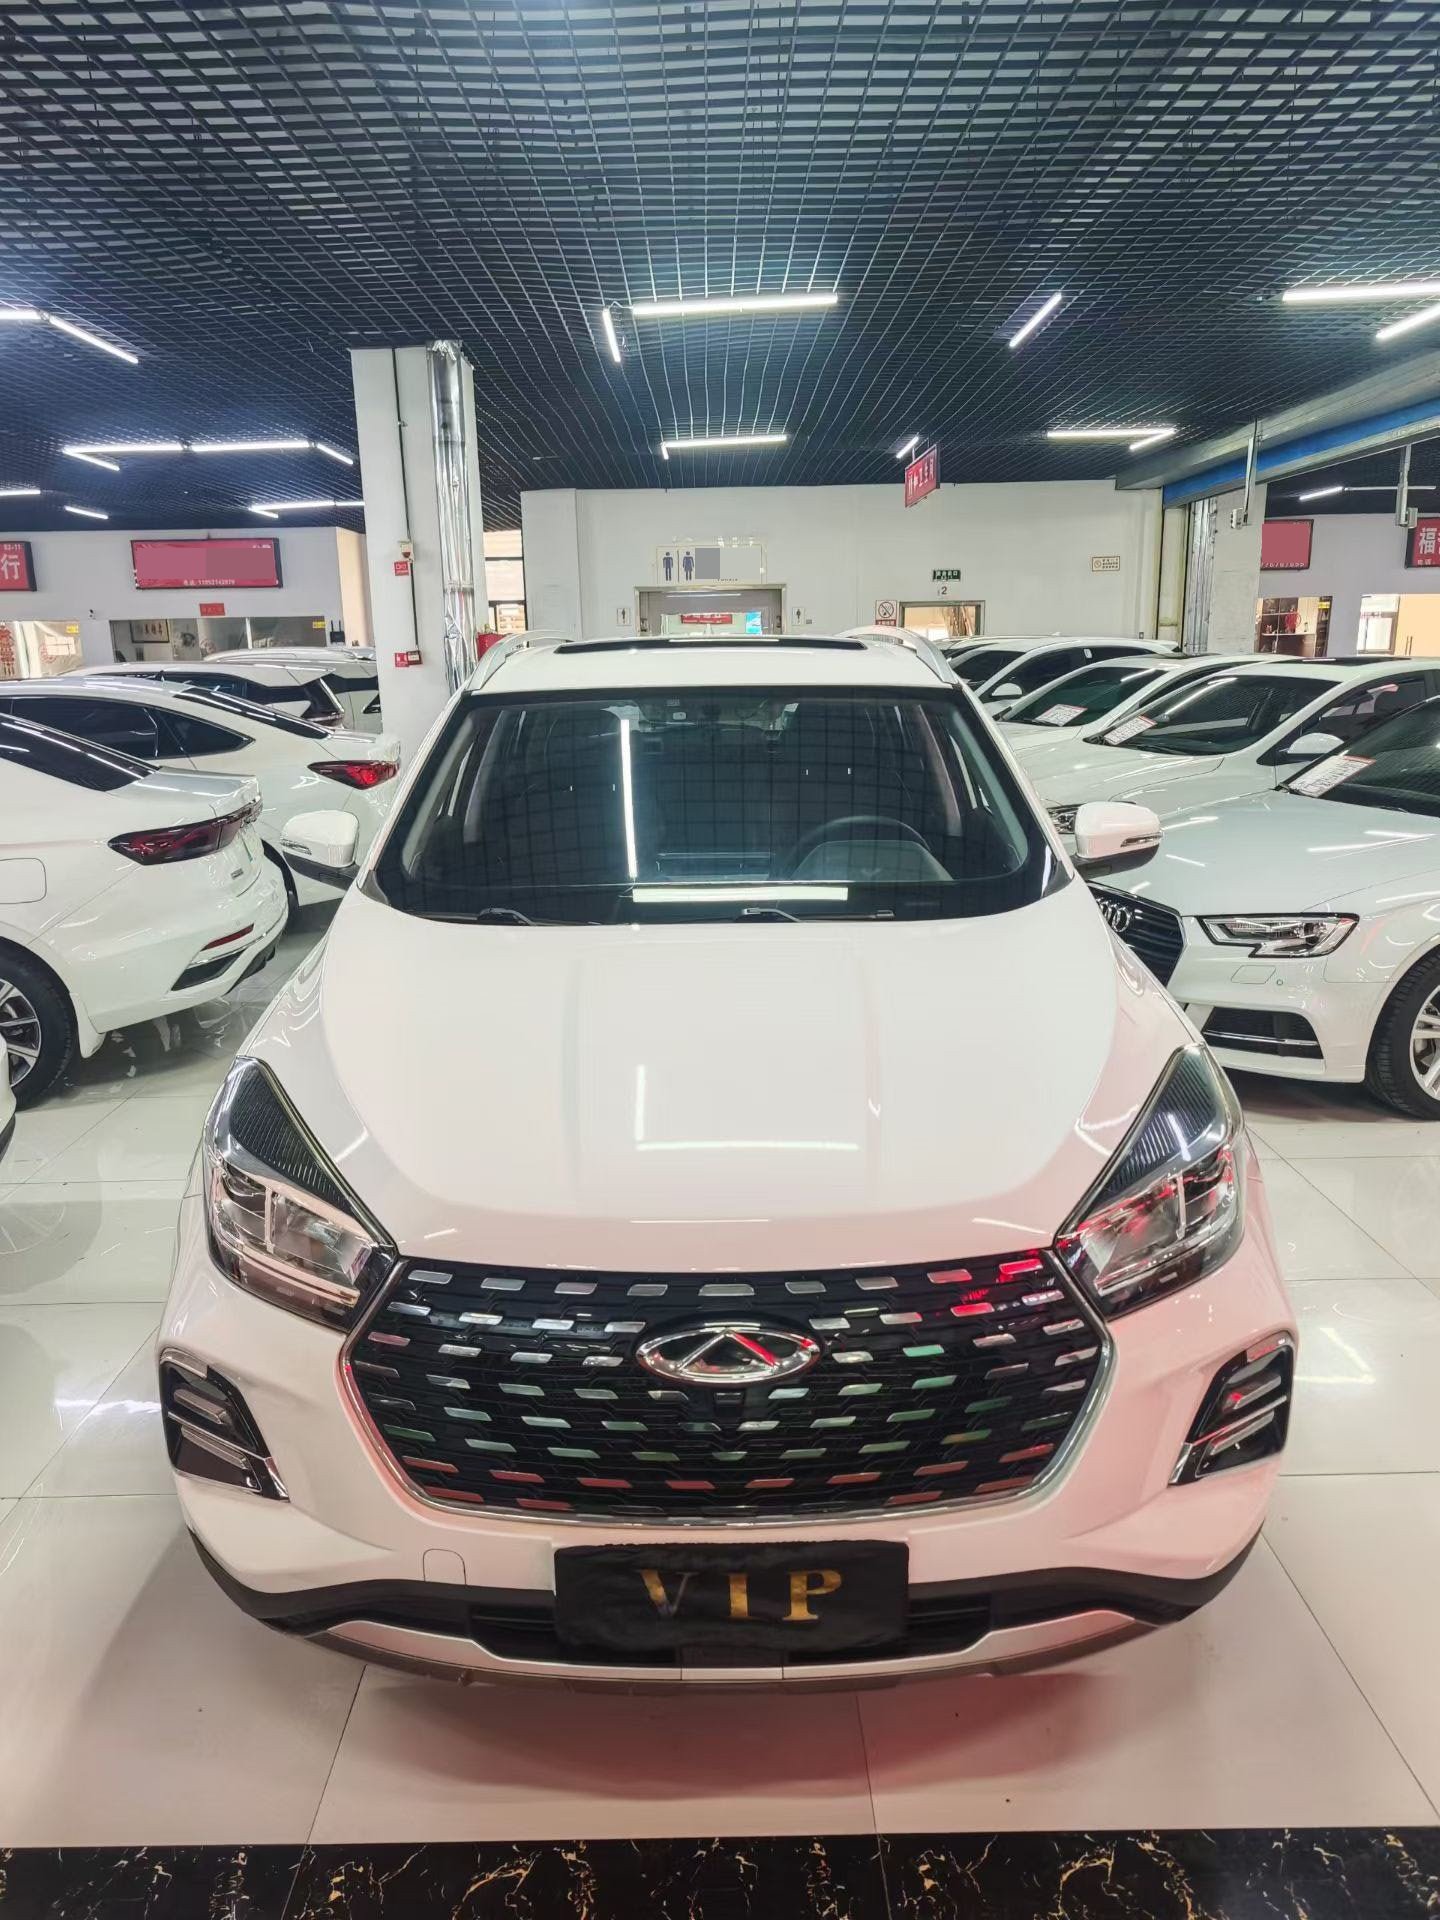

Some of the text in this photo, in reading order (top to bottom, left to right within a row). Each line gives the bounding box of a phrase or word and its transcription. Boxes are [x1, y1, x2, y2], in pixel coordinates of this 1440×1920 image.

[1419, 527, 1440, 554] 福
[1, 553, 21, 580] 行
[637, 1567, 843, 1621] VIP
